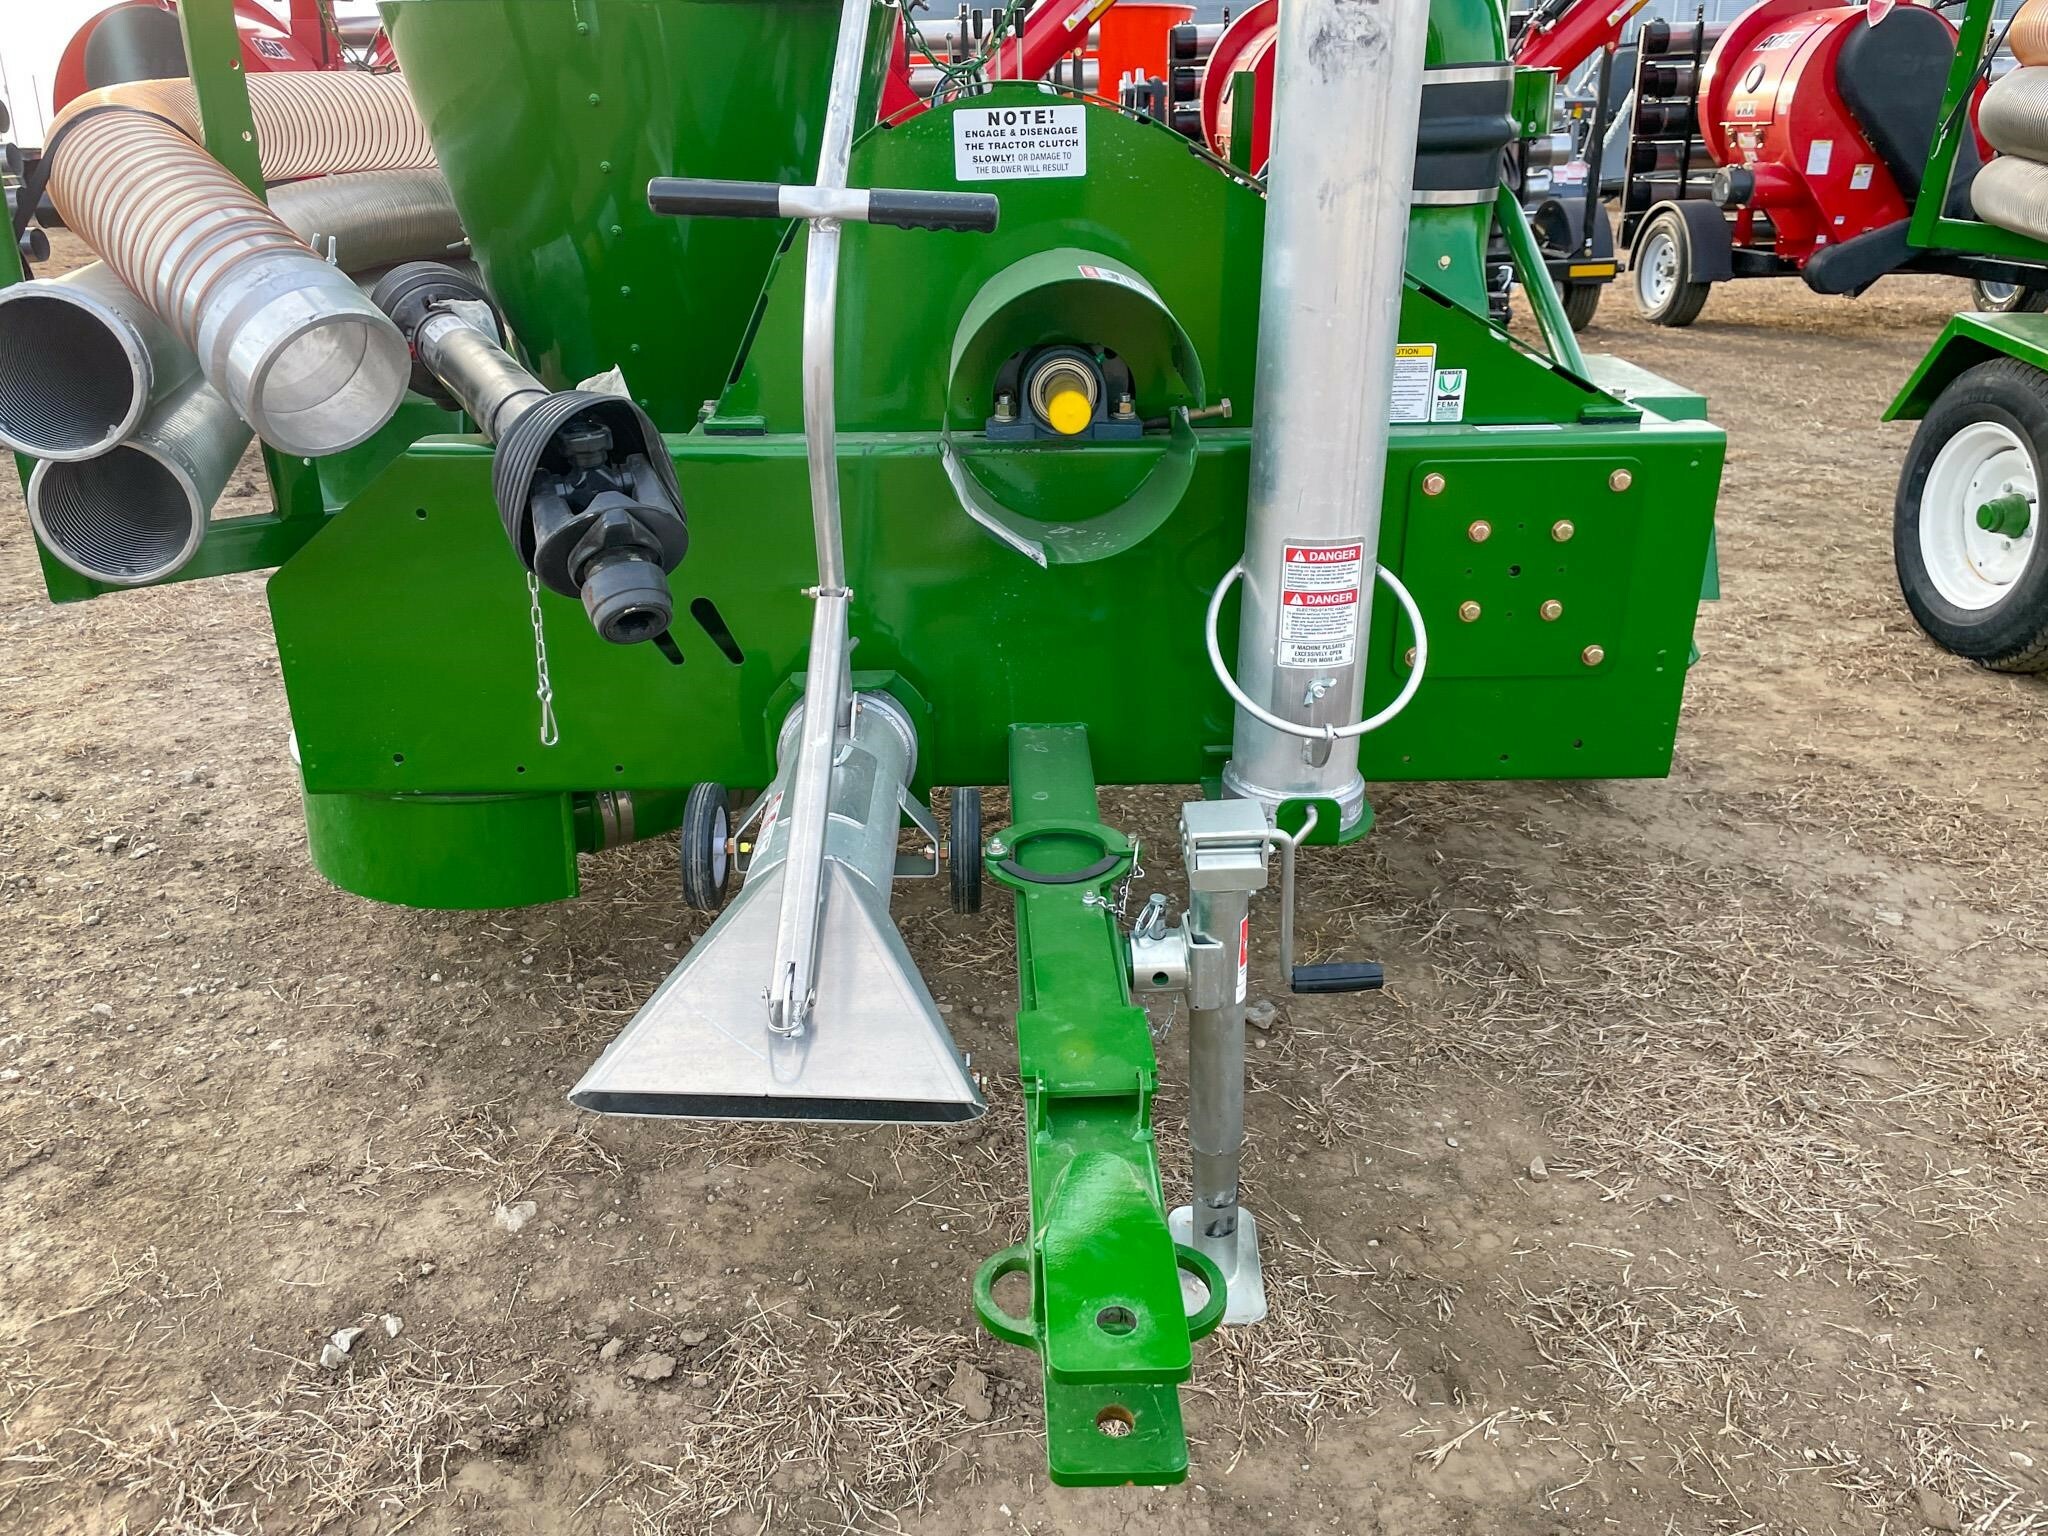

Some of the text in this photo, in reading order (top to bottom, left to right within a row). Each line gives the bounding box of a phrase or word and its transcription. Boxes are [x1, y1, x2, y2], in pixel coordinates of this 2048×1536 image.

[253, 39, 283, 57] AGI
[988, 109, 1054, 126] NOTE!
[965, 126, 1078, 138] ENGAGE & DISENGAGE
[965, 139, 1079, 151] THE TRACTOR CLUTCH
[972, 151, 1072, 163] SLOWLY! OR DAMAGE TO
[975, 166, 990, 174] THE
[991, 165, 1022, 174] BLOWER
[1023, 164, 1040, 173] WILL
[1042, 163, 1069, 172] RESULT
[1309, 549, 1356, 562] DANGER
[1306, 592, 1353, 605] DANGER
